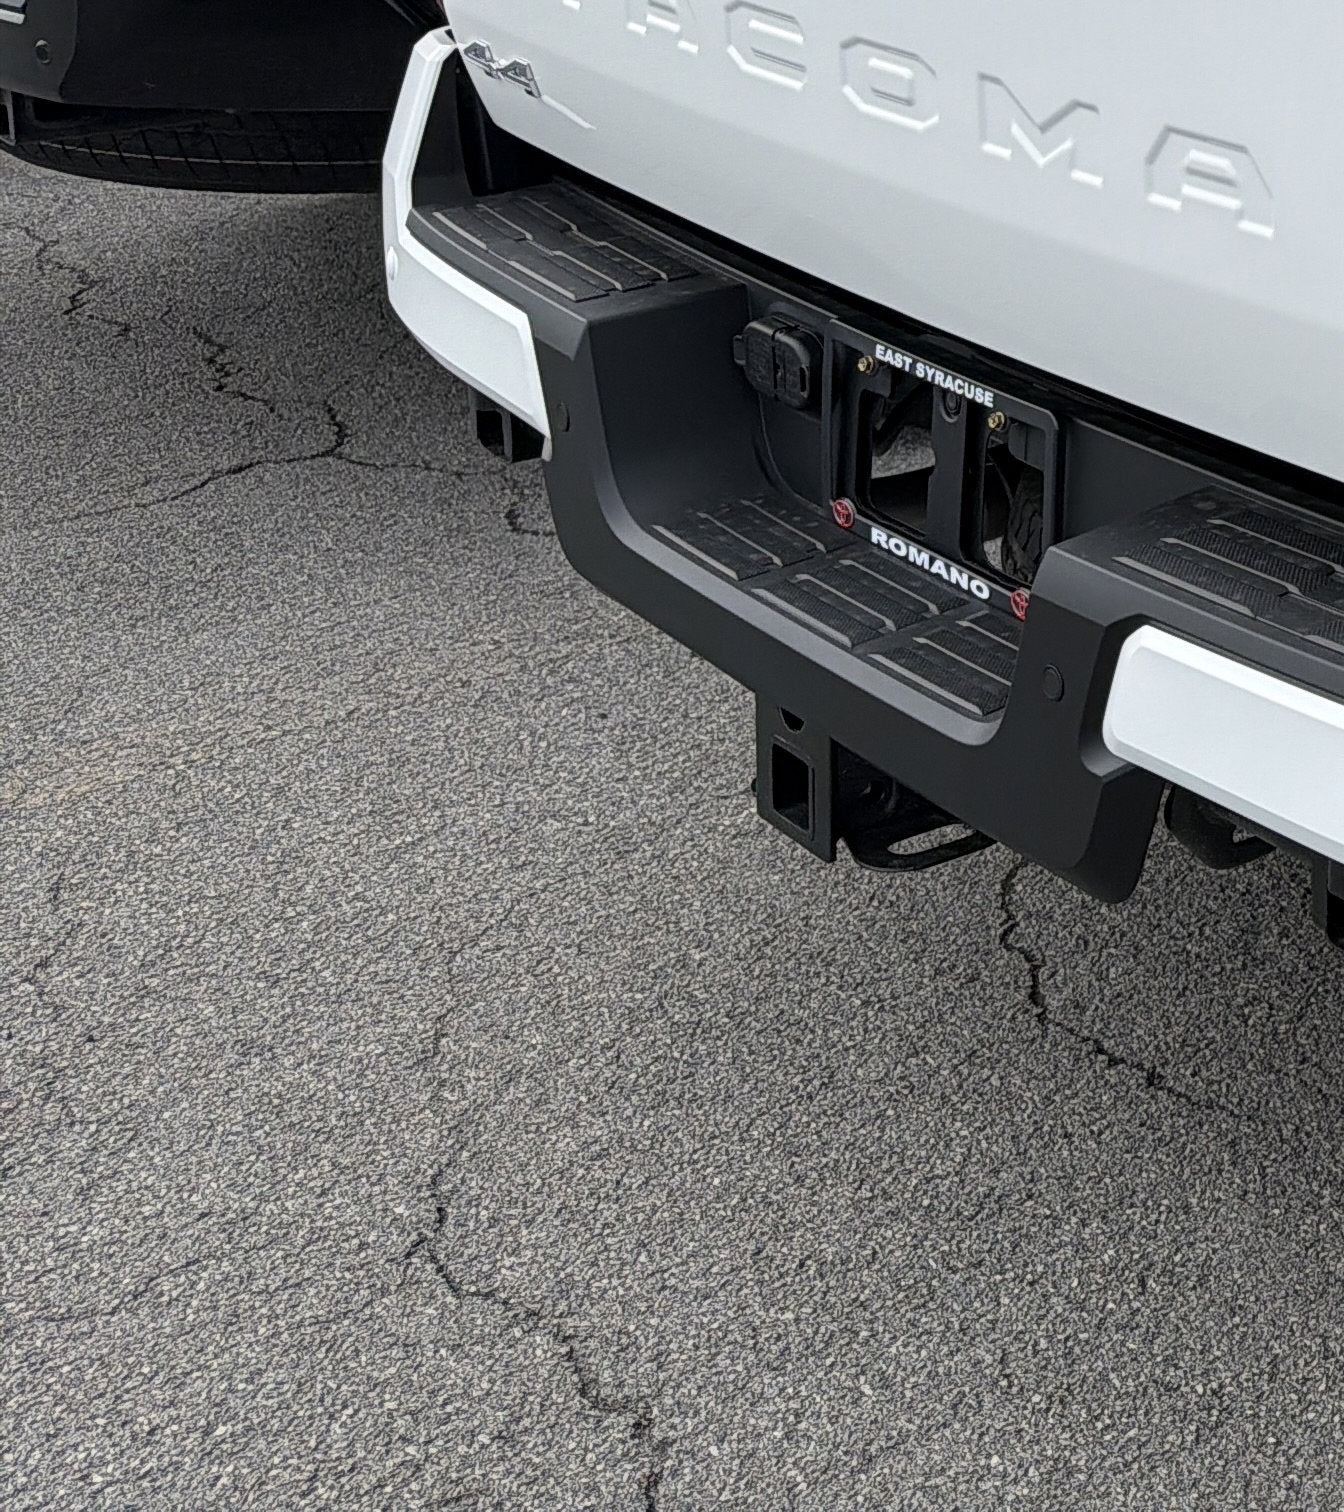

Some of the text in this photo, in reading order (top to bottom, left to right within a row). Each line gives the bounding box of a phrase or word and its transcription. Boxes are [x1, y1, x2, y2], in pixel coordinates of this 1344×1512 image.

[875, 343, 995, 408] EAST SYRACUSE
[870, 526, 991, 600] ROMANO
